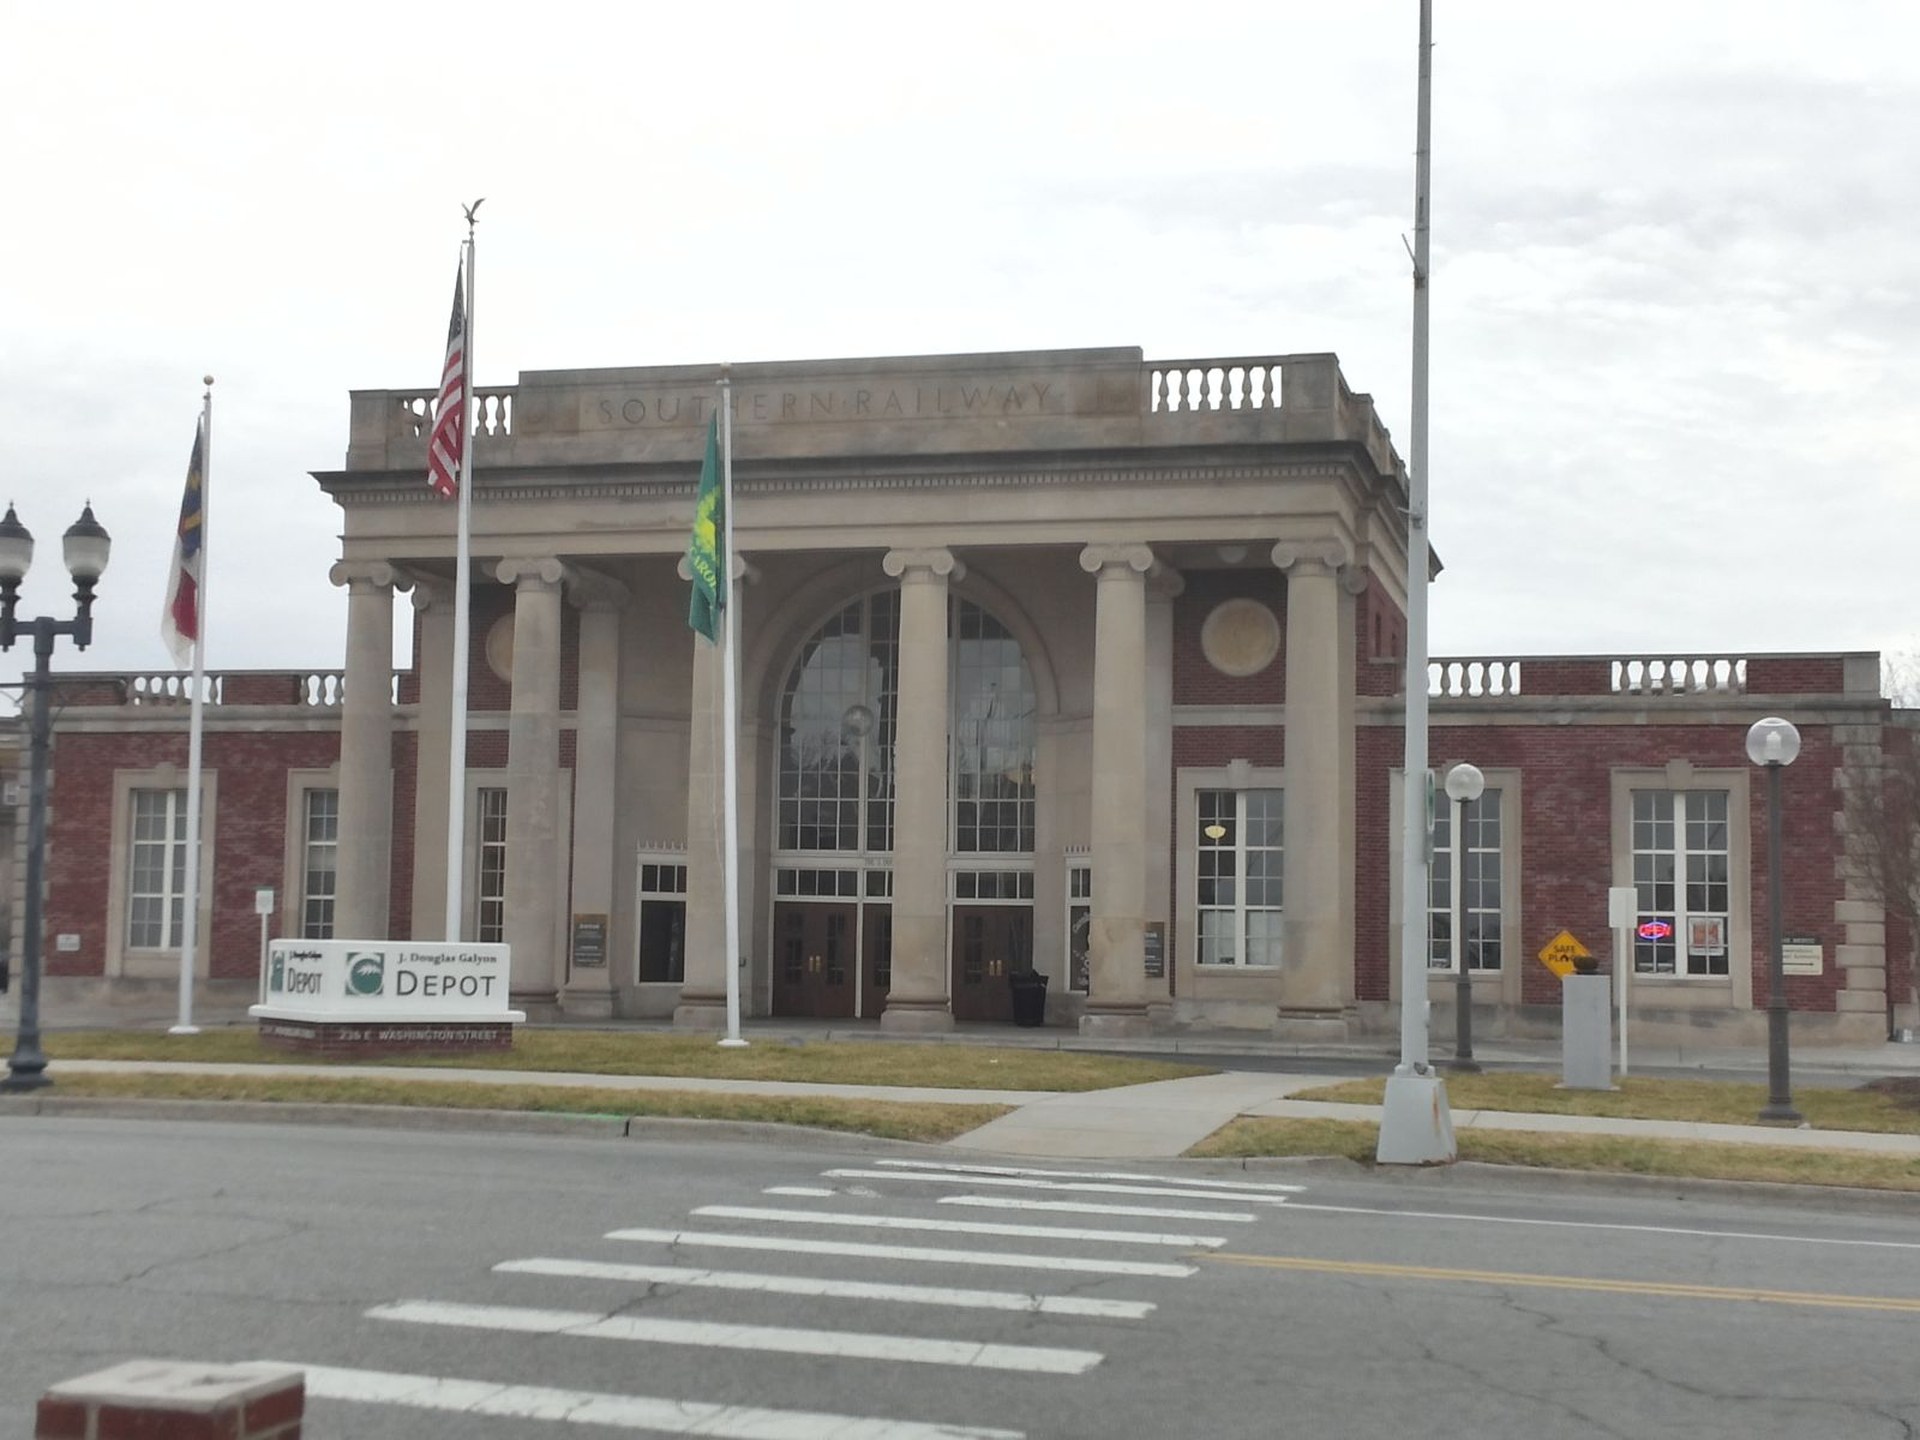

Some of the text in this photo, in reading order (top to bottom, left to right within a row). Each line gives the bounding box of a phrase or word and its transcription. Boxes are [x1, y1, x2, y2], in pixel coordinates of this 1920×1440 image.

[856, 383, 1051, 415] RAILWAY
[397, 953, 497, 966] J. Douglas Galyon
[287, 967, 322, 994] DEPOT
[396, 970, 496, 996] DEPOT
[378, 1029, 454, 1041] WASHINGTON
[456, 1029, 498, 1041] STREET
